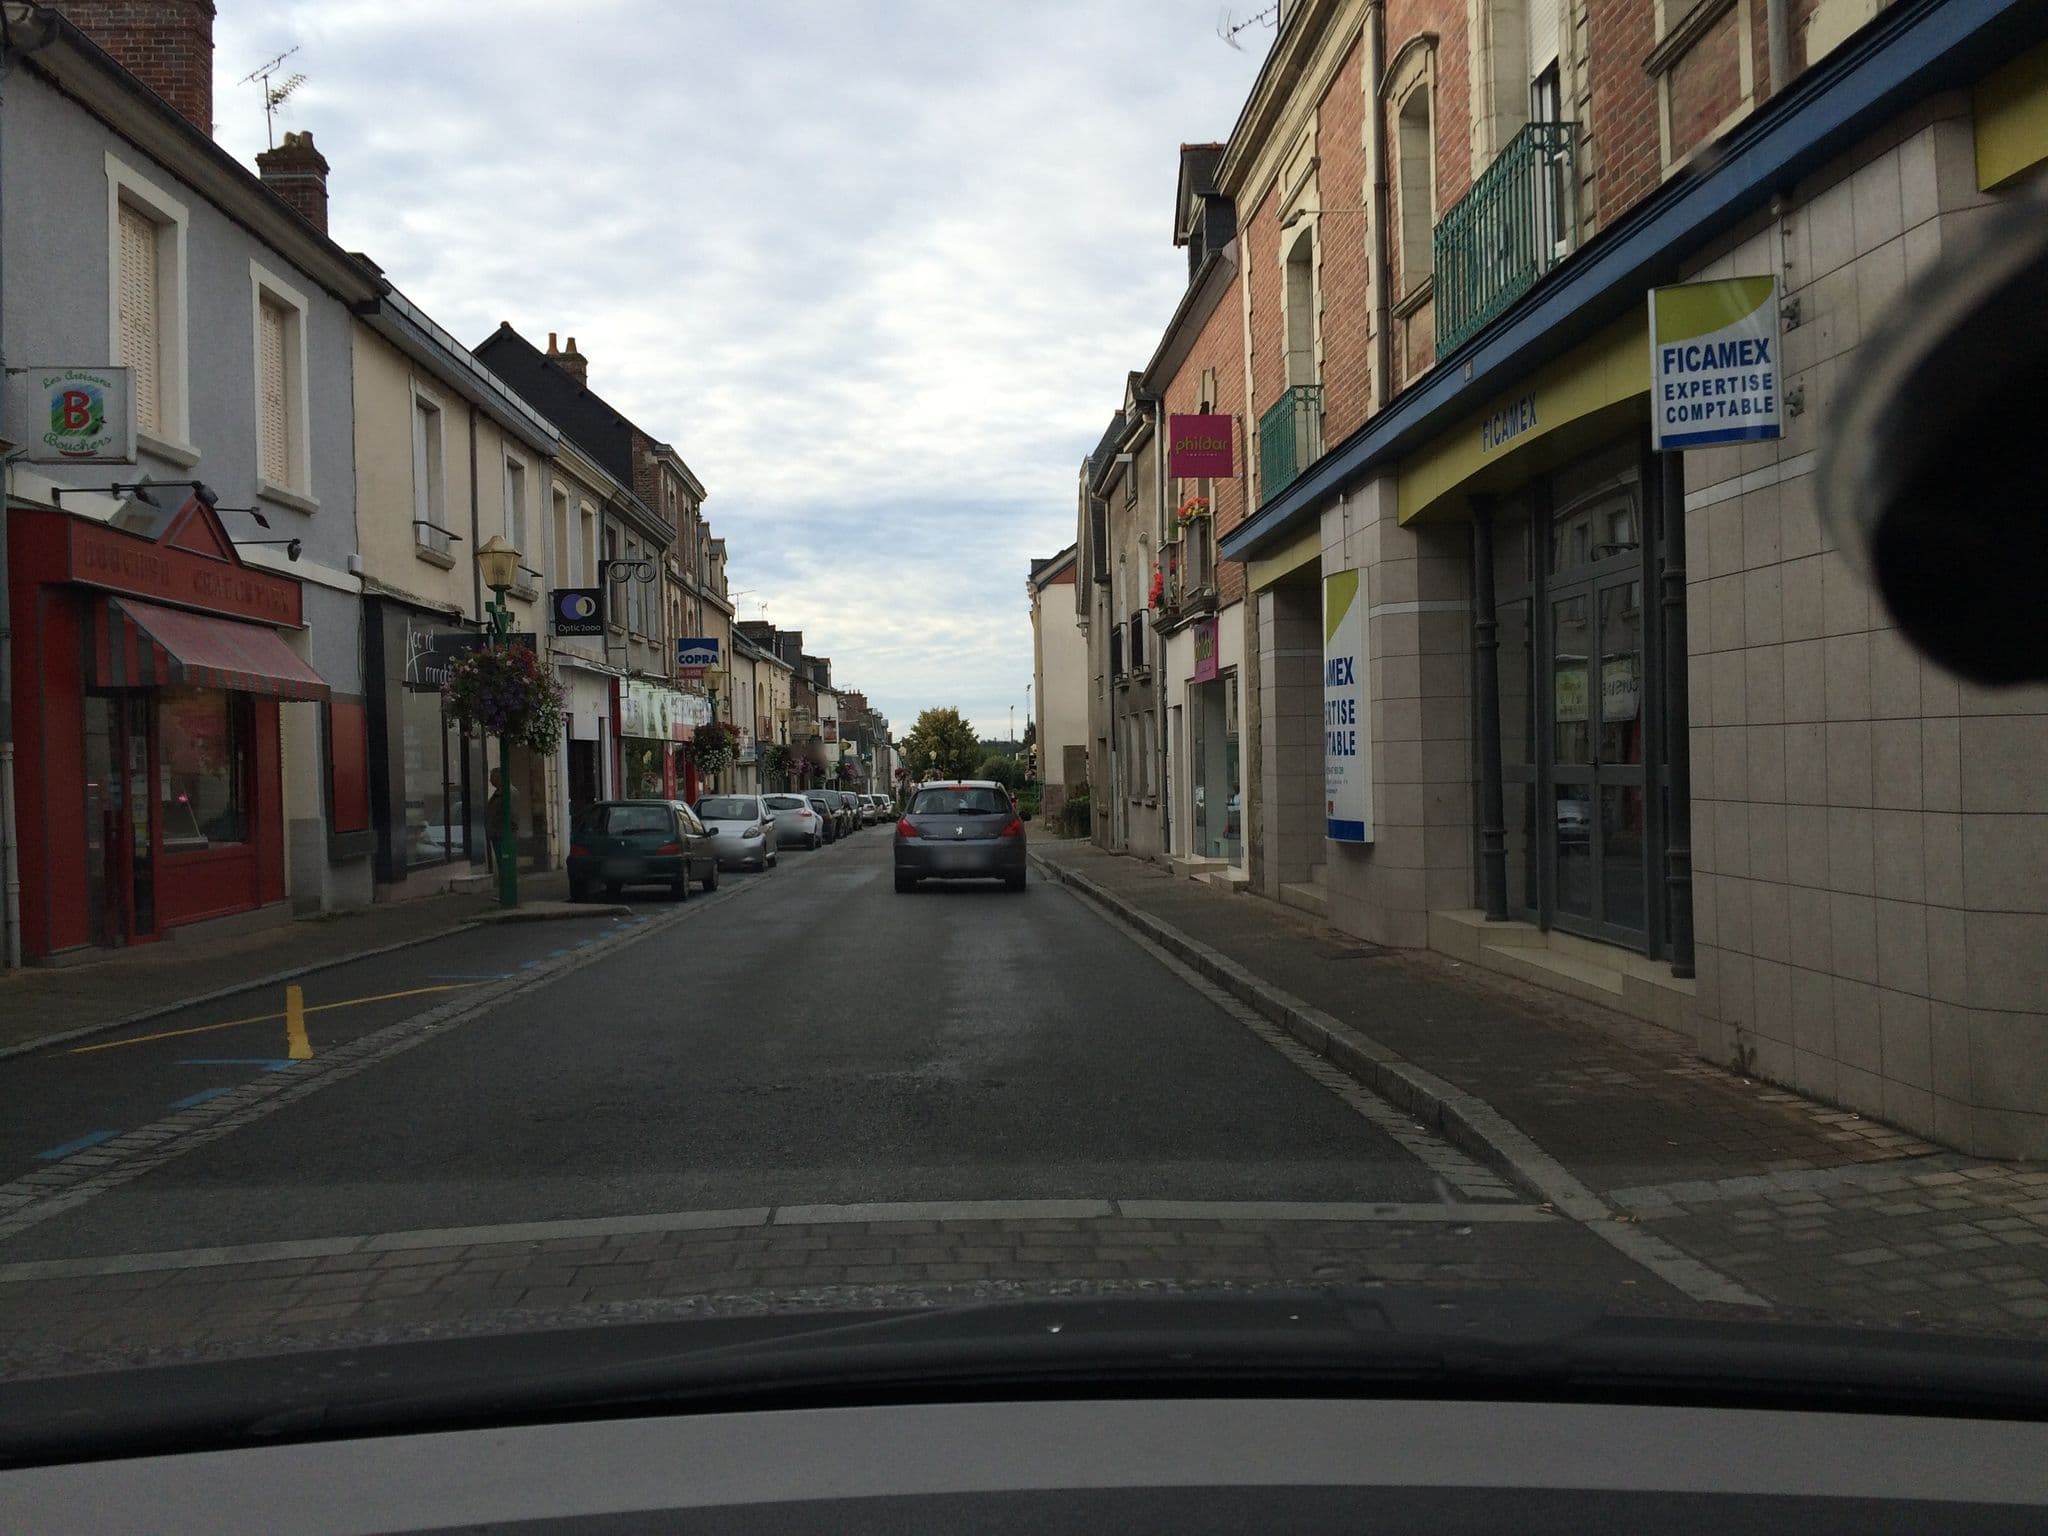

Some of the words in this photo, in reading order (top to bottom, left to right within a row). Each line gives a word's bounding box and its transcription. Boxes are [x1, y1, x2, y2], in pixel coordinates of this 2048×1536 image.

[1663, 338, 1771, 375] FICAMEX
[42, 376, 61, 389] Les
[1664, 373, 1772, 401] EXPERTISE
[63, 390, 90, 430] B
[1482, 389, 1537, 453] FICAMEX
[1666, 396, 1773, 424] COMPTABLE
[43, 432, 112, 451] Bouchers
[1175, 436, 1228, 455] phildar
[678, 654, 719, 665] COPRA
